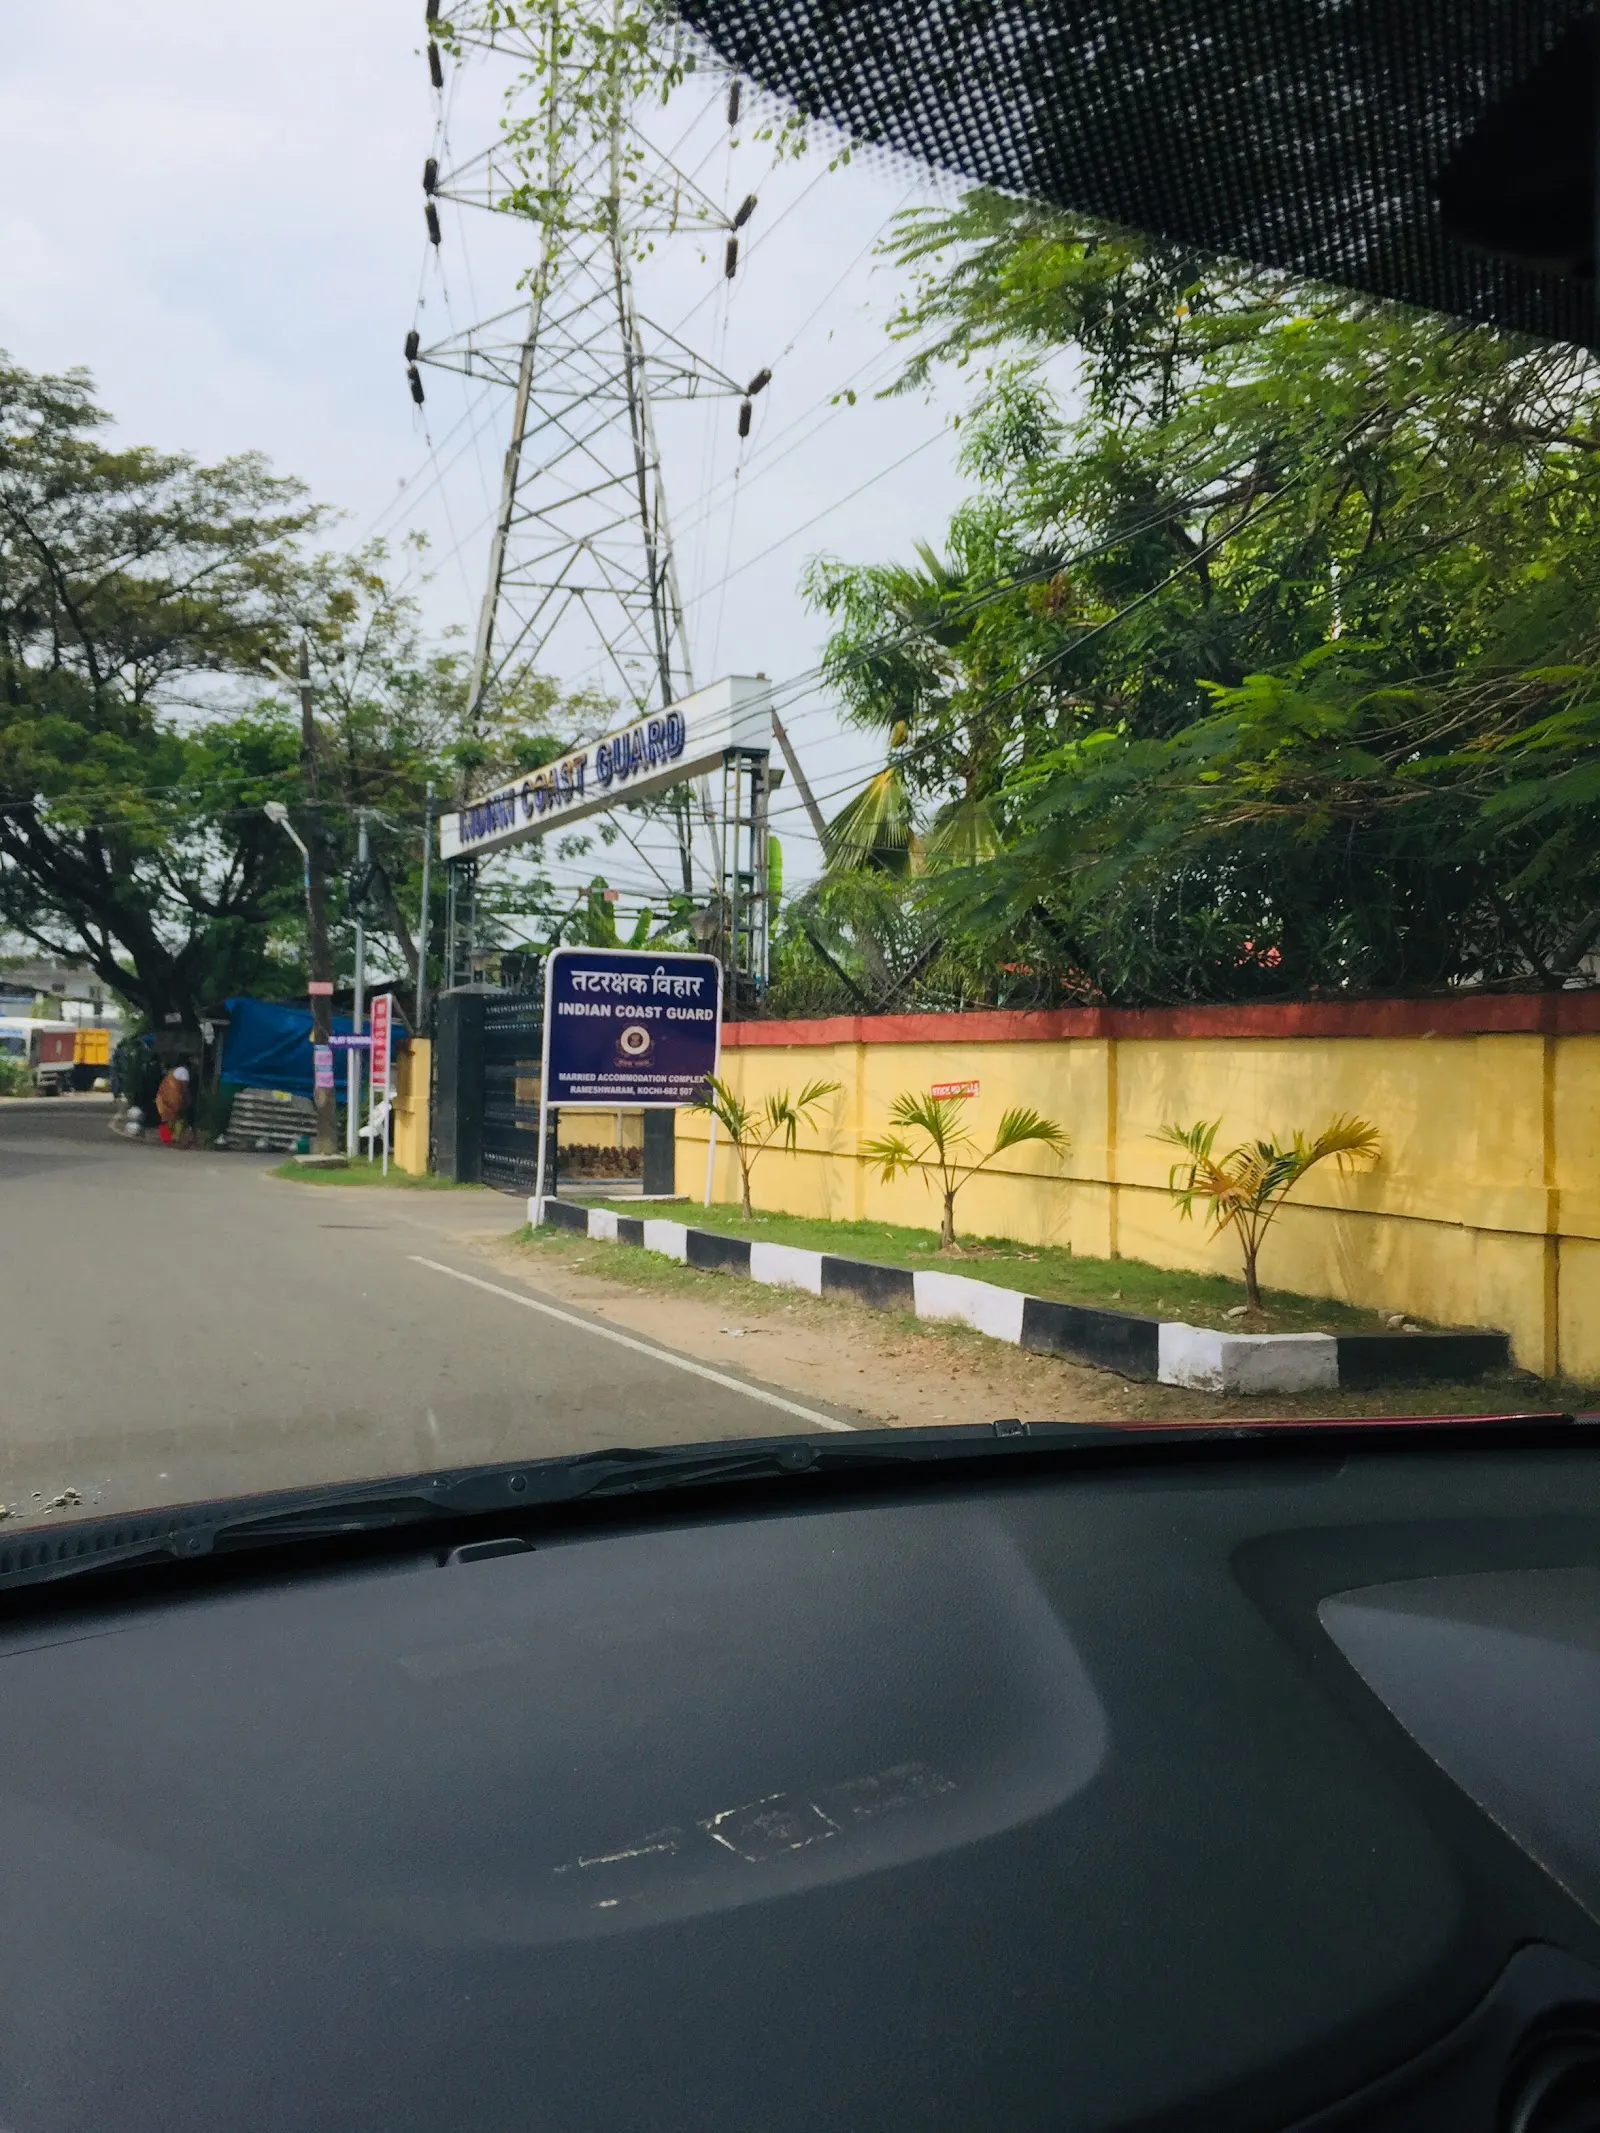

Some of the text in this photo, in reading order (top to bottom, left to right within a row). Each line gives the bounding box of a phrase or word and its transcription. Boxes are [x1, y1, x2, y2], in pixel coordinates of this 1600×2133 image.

[522, 754, 587, 820] COAST
[596, 710, 686, 787] GUARD
[570, 966, 704, 997] तटरक्षक विहार
[558, 1002, 714, 1021] INDIAN COAST GUARD
[559, 1072, 705, 1084] MARRIED ACCOMMODATION COMPLEX
[570, 1085, 635, 1095] RAMESHWARAM,
